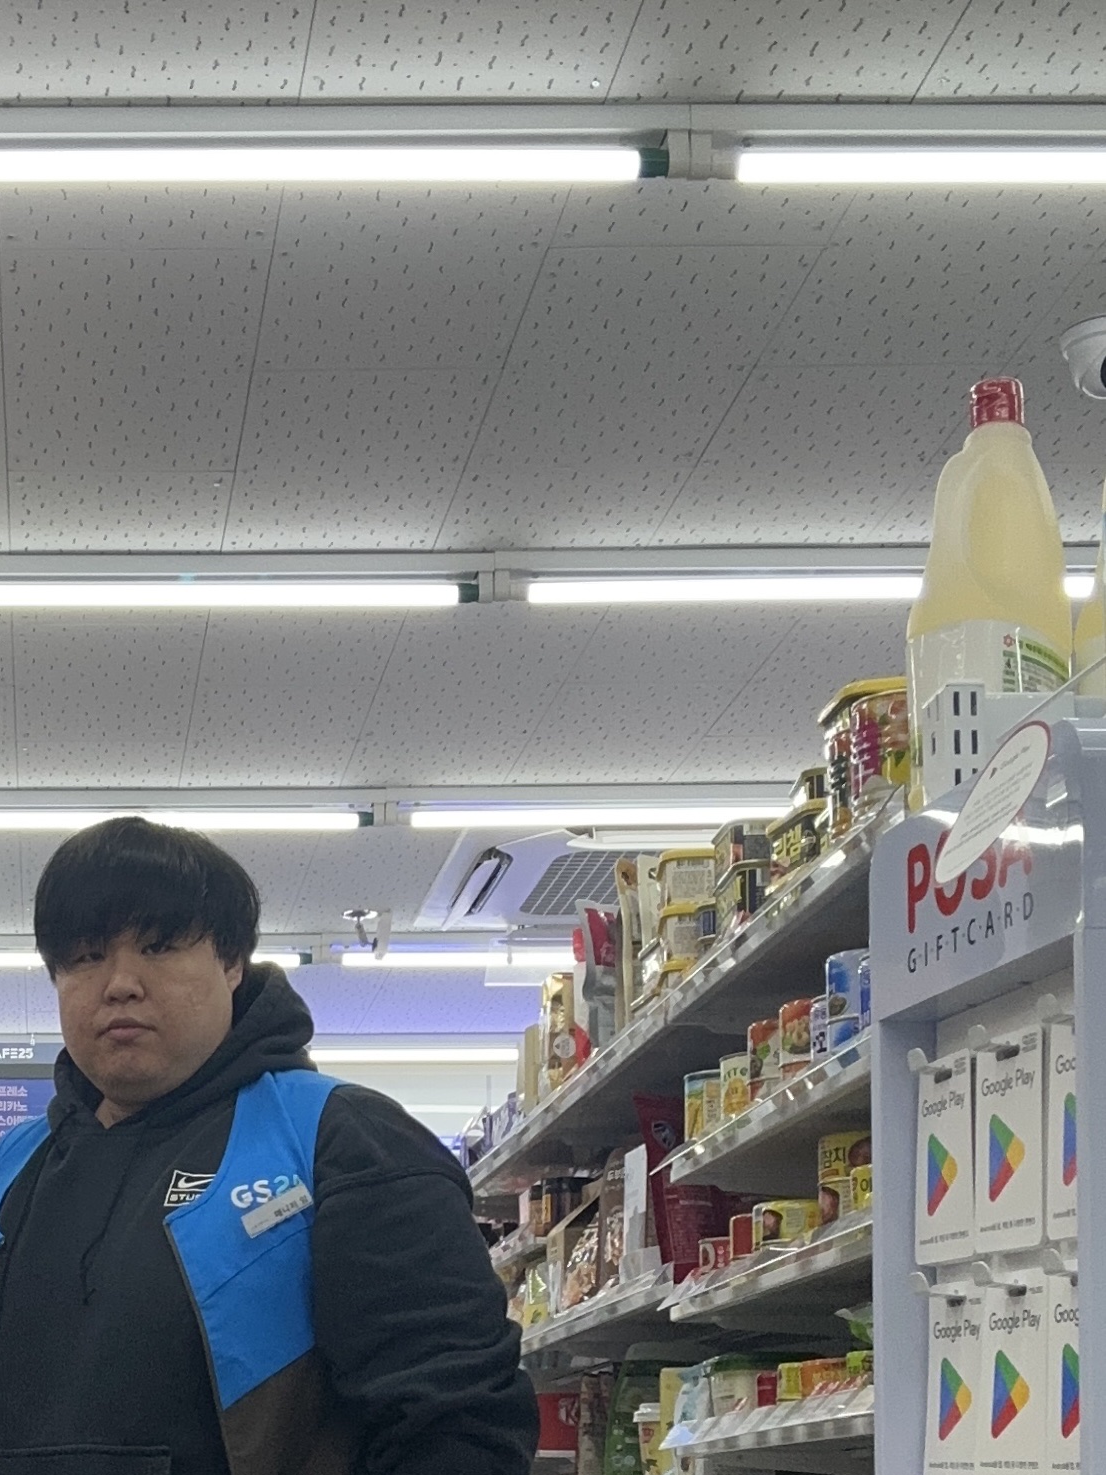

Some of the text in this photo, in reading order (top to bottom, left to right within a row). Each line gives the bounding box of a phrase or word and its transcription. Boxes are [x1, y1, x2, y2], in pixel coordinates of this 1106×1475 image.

[980, 1068, 1037, 1098] Google Play
[921, 1090, 967, 1119] Google Play
[933, 1319, 981, 1343] Google Play
[988, 1309, 1042, 1335] Google Play
